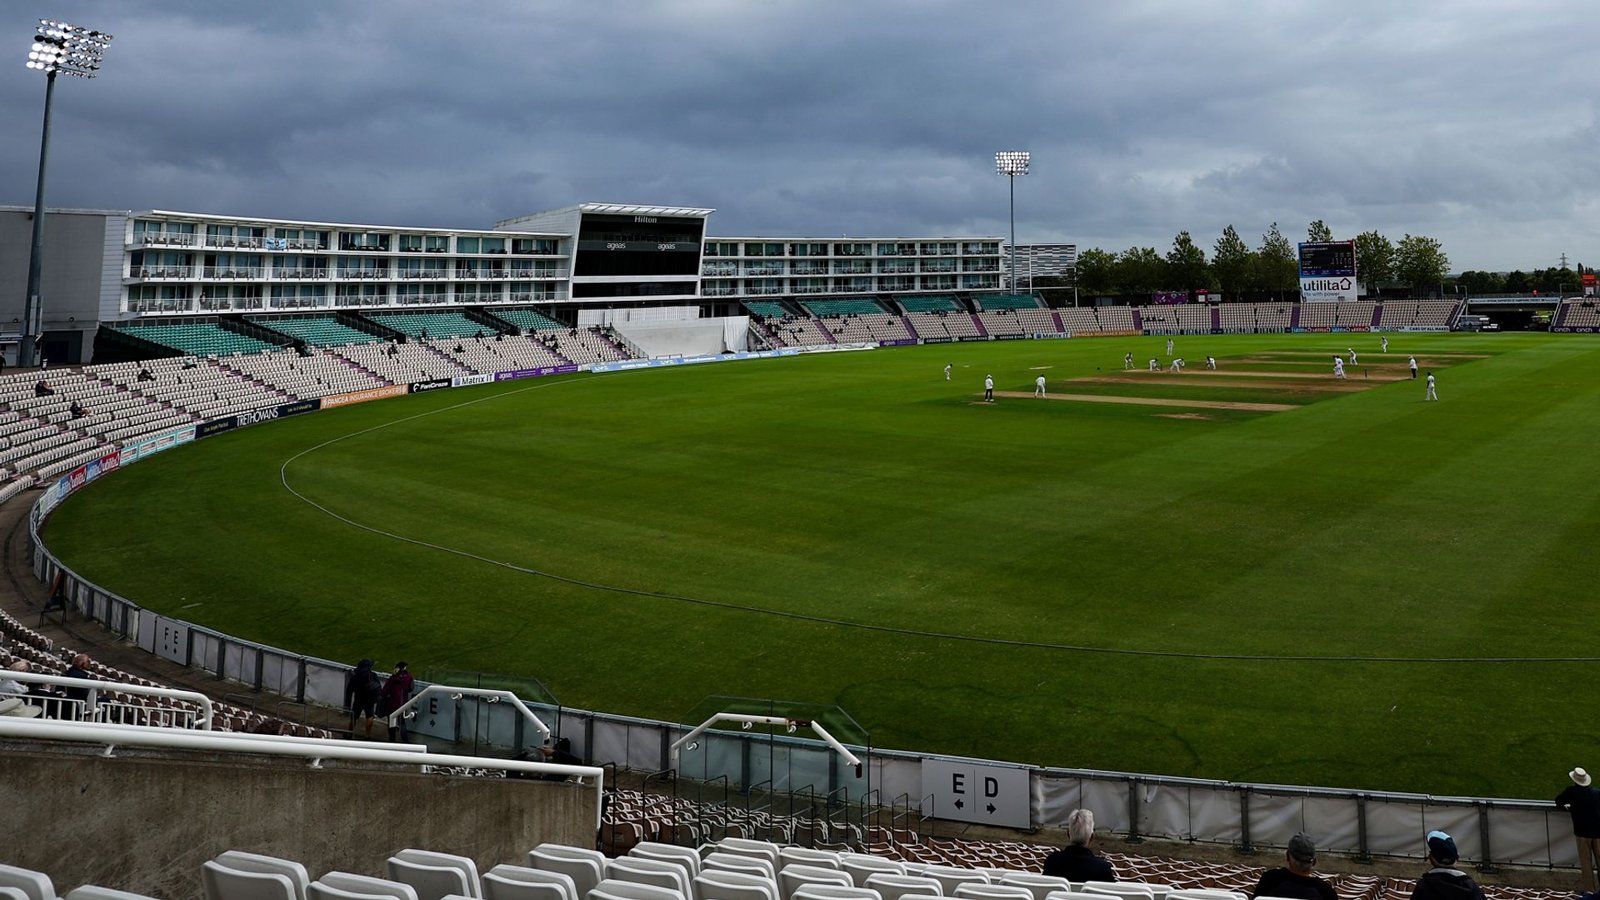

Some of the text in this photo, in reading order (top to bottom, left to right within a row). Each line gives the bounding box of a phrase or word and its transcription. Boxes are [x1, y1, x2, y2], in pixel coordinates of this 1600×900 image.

[634, 215, 657, 223] Hilton
[606, 243, 626, 251] ageas
[1303, 280, 1340, 291] utilita
[462, 374, 492, 385] Matrix IT
[327, 387, 400, 405] PANGEA INSURANCE BROKERS
[236, 407, 279, 427] TRETHOWANS
[165, 627, 178, 644] F E
[430, 697, 438, 715] E
[953, 773, 998, 798] E D
